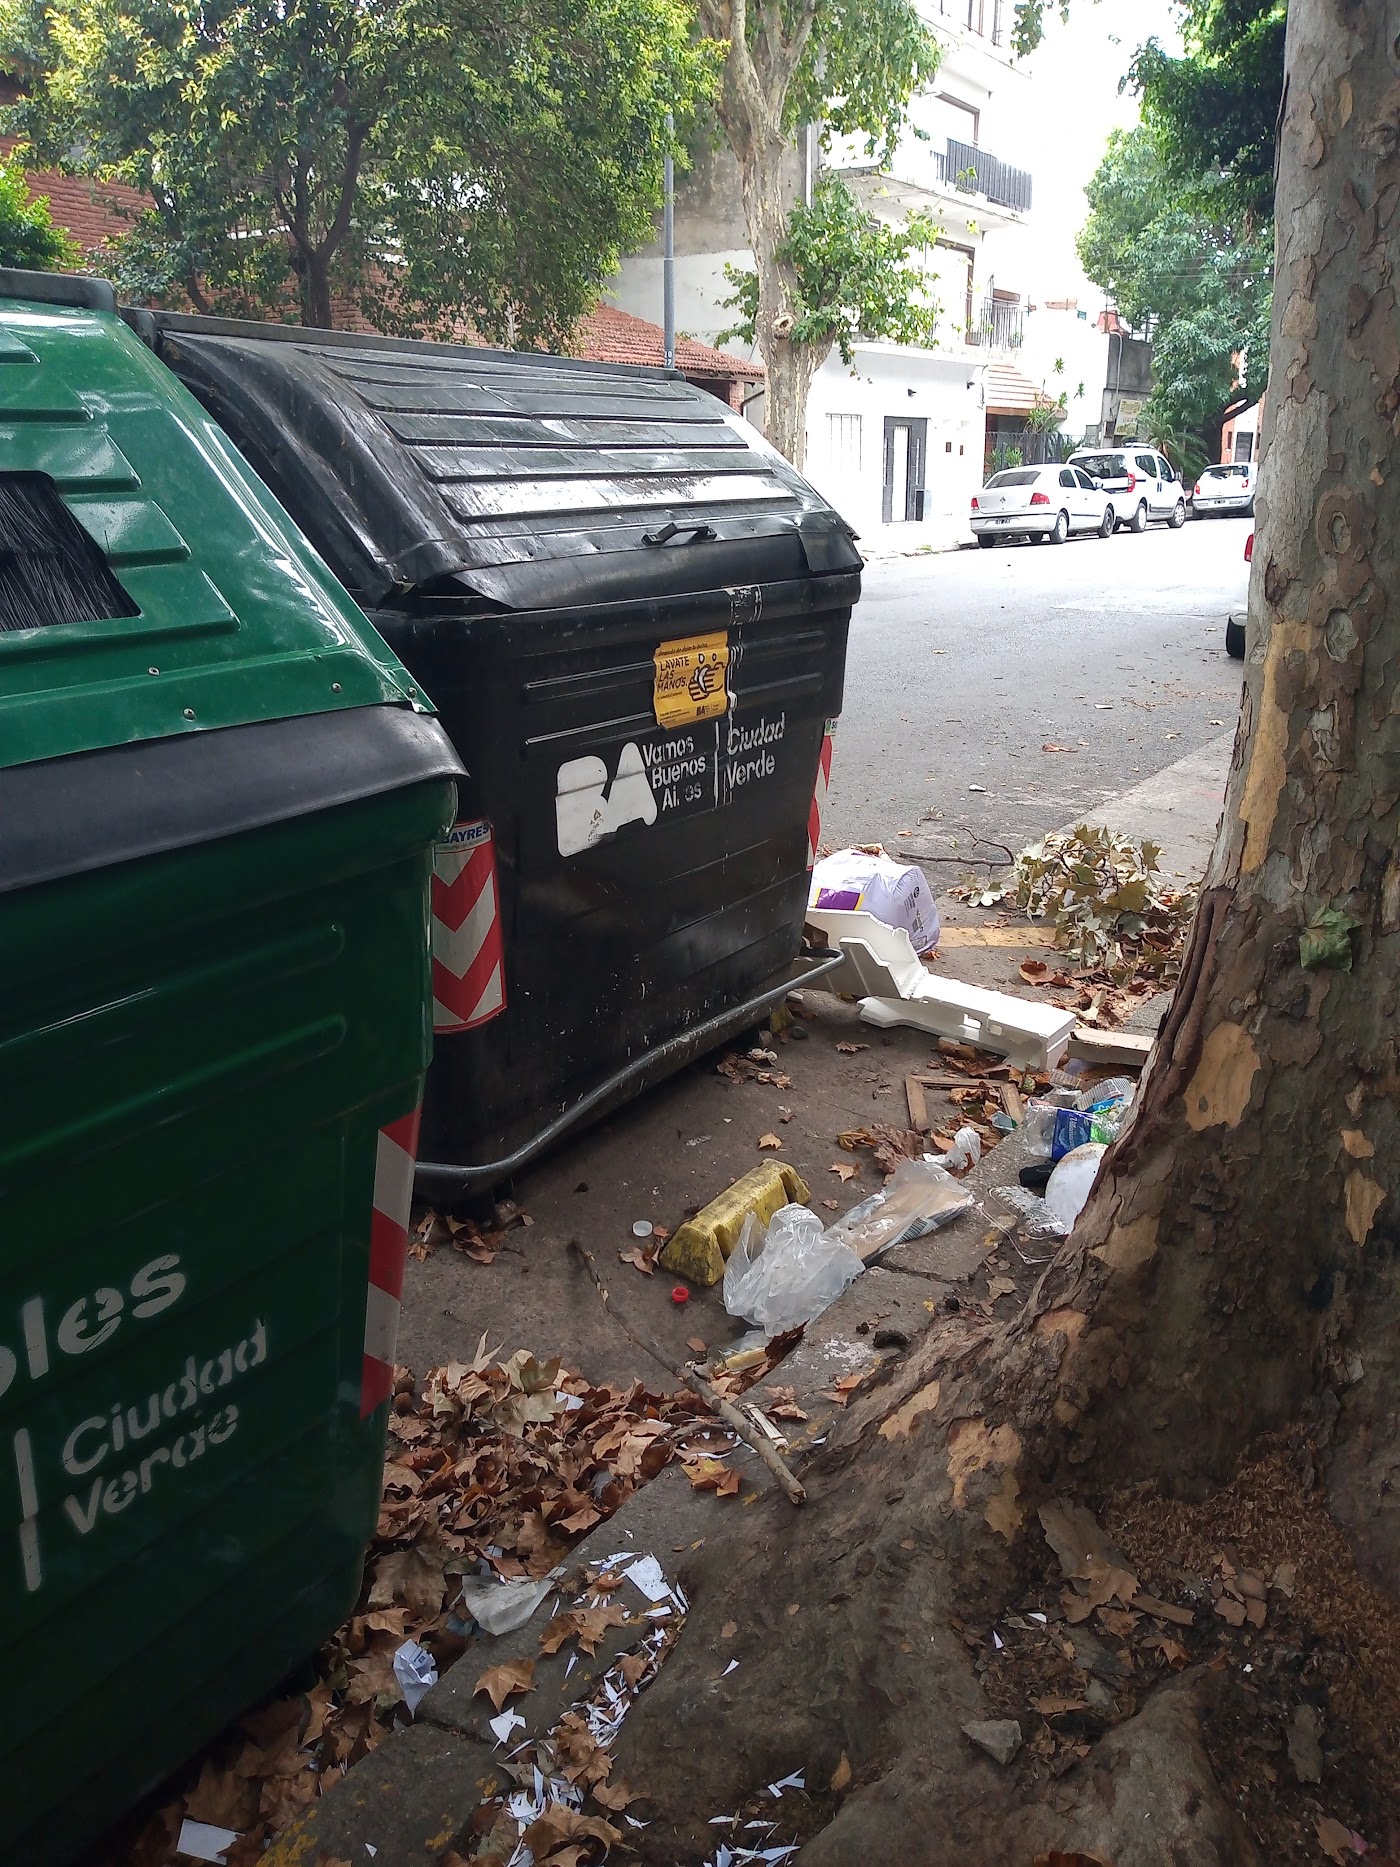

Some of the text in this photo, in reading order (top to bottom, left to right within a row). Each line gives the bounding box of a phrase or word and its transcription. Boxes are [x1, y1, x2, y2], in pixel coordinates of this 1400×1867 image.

[659, 669, 675, 682] LAS
[660, 656, 690, 672] LAVATE
[727, 711, 786, 755] Ciudad
[643, 736, 695, 767] Vamos
[652, 755, 706, 789] Buenos
[726, 750, 776, 789] Verde
[555, 742, 658, 857] BA
[661, 782, 702, 811] Aies
[62, 1317, 267, 1476] Ciudad
